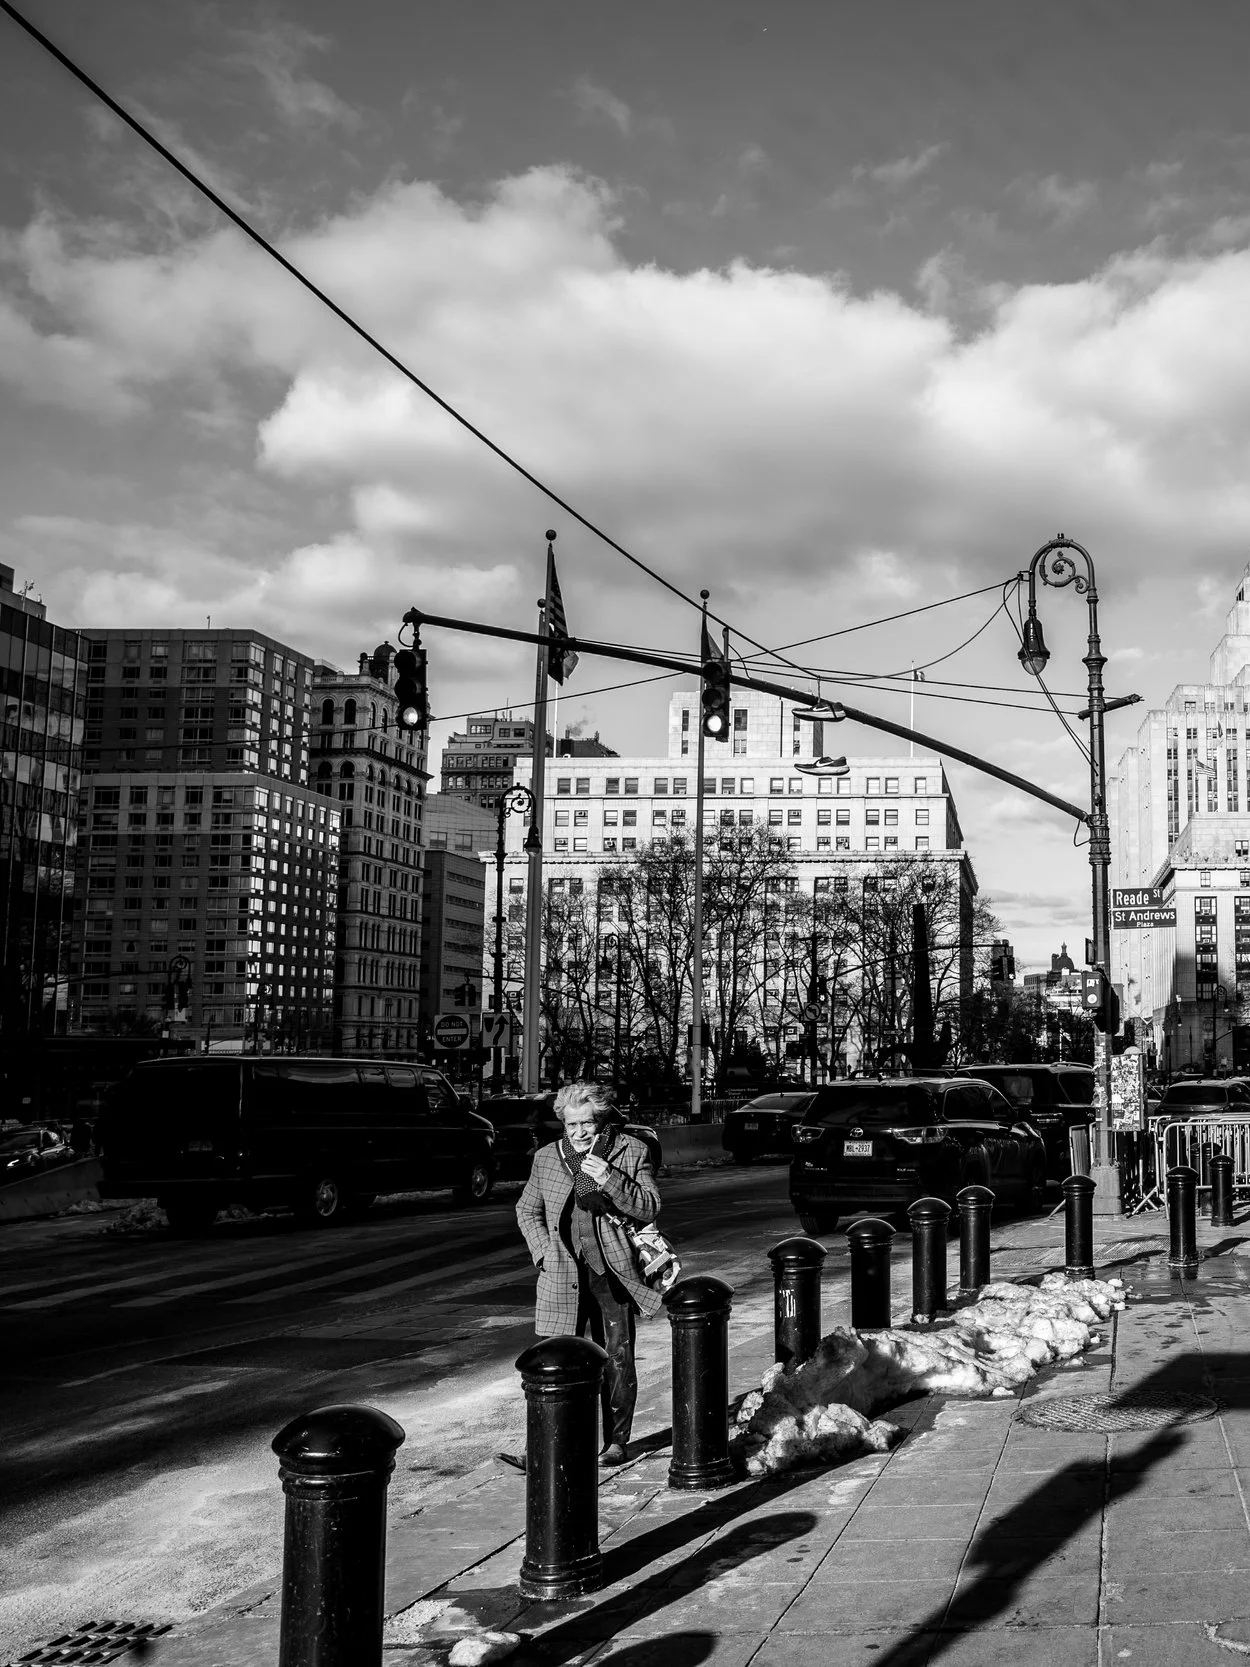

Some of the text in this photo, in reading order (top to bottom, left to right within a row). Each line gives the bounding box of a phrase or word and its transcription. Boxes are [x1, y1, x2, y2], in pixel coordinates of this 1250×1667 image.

[1116, 888, 1161, 906] Reade St
[1115, 910, 1175, 922] St Andrews
